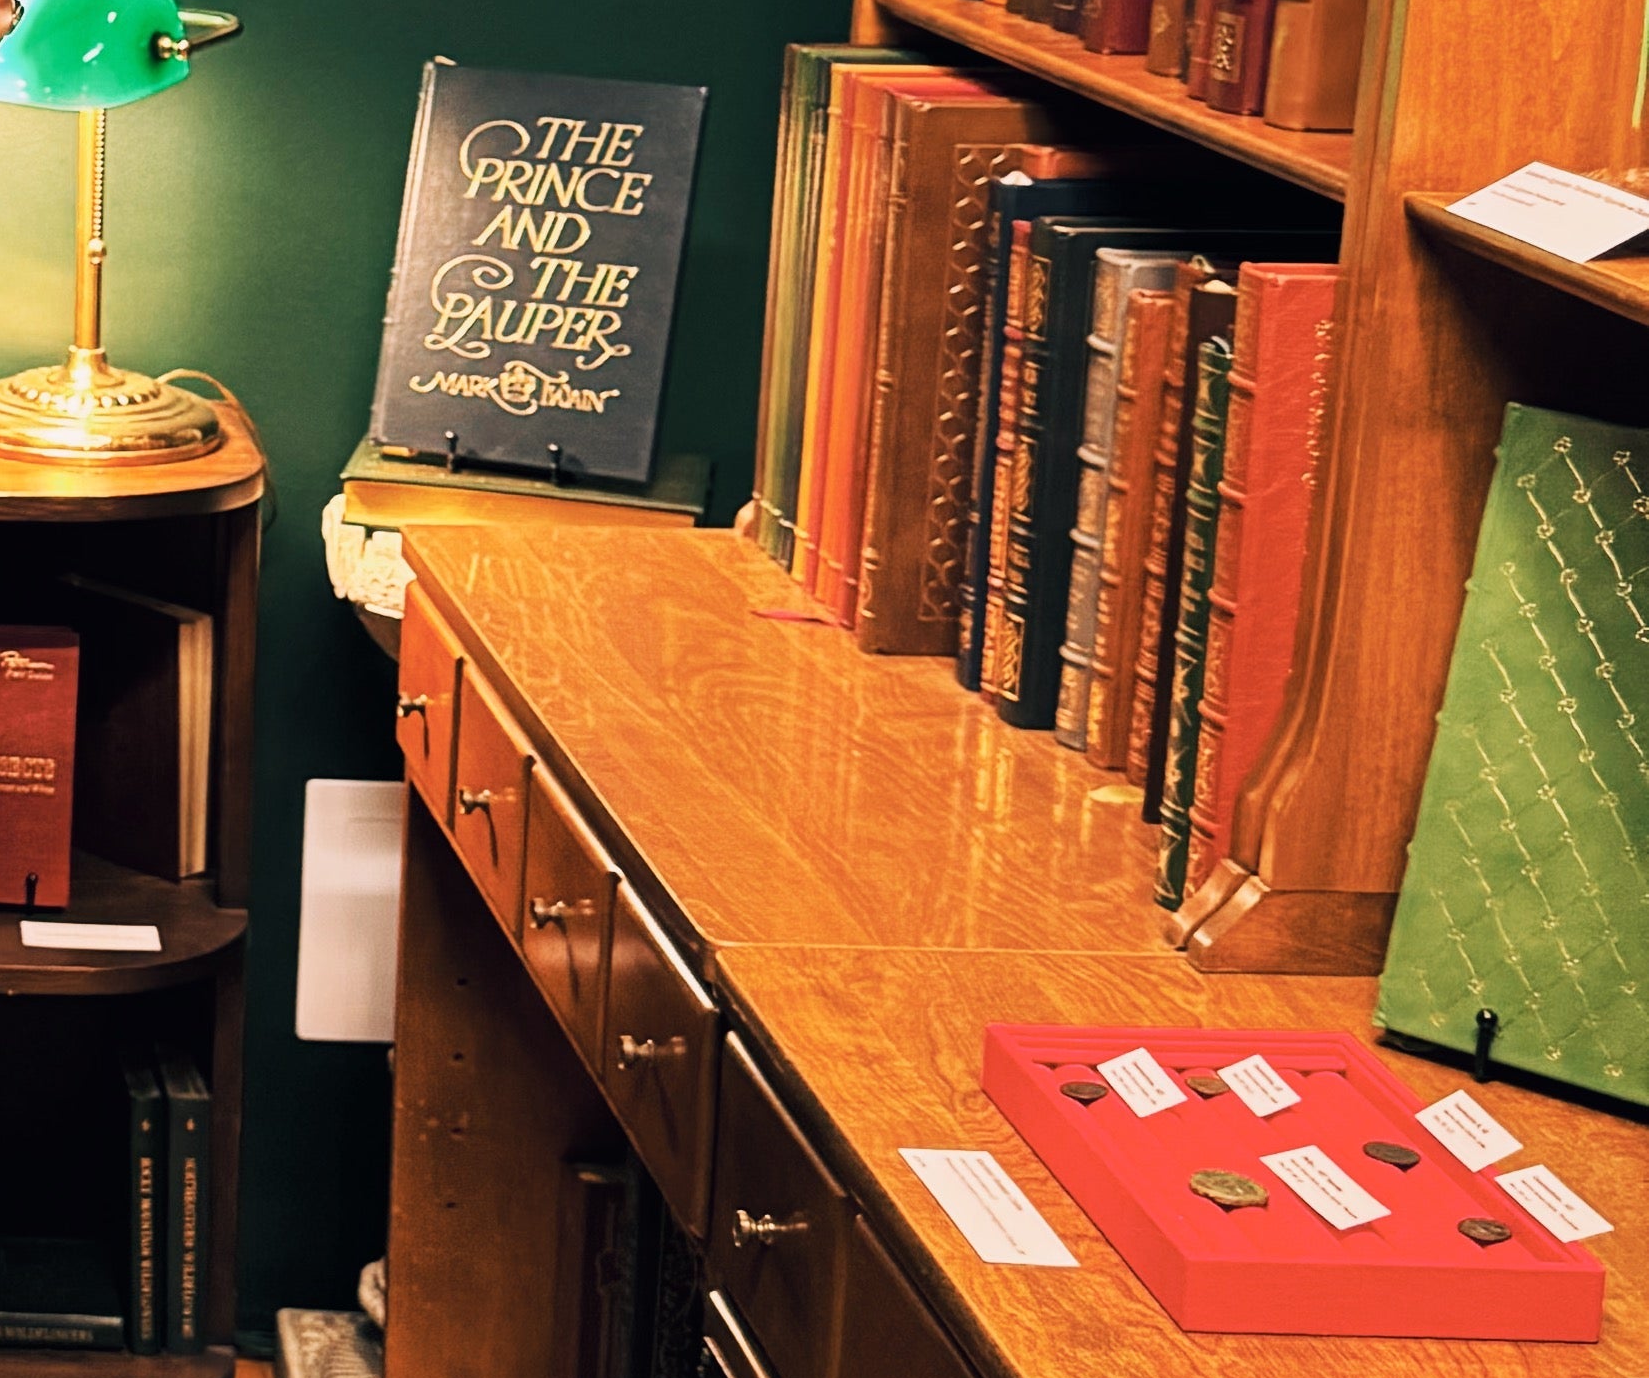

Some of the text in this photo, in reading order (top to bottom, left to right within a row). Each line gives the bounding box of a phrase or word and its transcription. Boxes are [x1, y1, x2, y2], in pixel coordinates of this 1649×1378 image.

[536, 116, 645, 167] THE
[461, 131, 652, 216] PRINCE
[472, 204, 591, 255] AND
[529, 256, 639, 308] THE
[425, 273, 631, 370] PAUPER
[409, 364, 620, 414] MARK TWAIN
